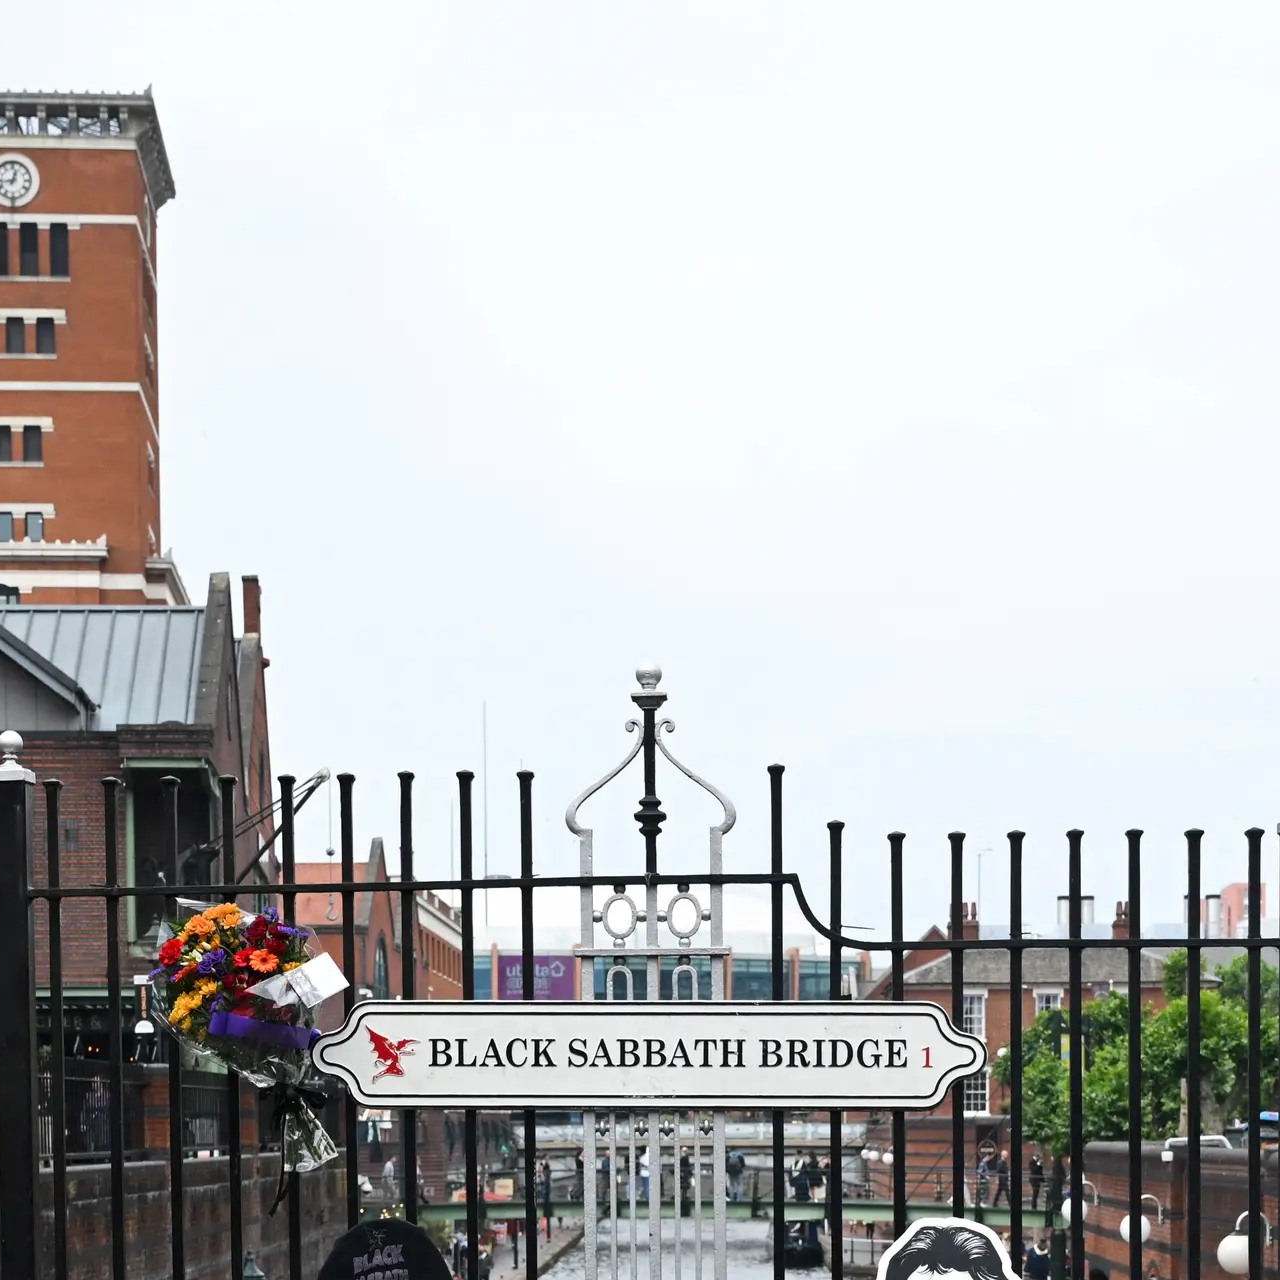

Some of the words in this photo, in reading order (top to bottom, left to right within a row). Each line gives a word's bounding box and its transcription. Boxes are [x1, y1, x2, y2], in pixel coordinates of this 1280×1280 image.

[428, 1038, 557, 1068] BLACK
[568, 1038, 746, 1068] SABBATH
[758, 1038, 908, 1069] BRIDGE
[921, 1047, 933, 1069] 1
[353, 1245, 404, 1275] BLACK
